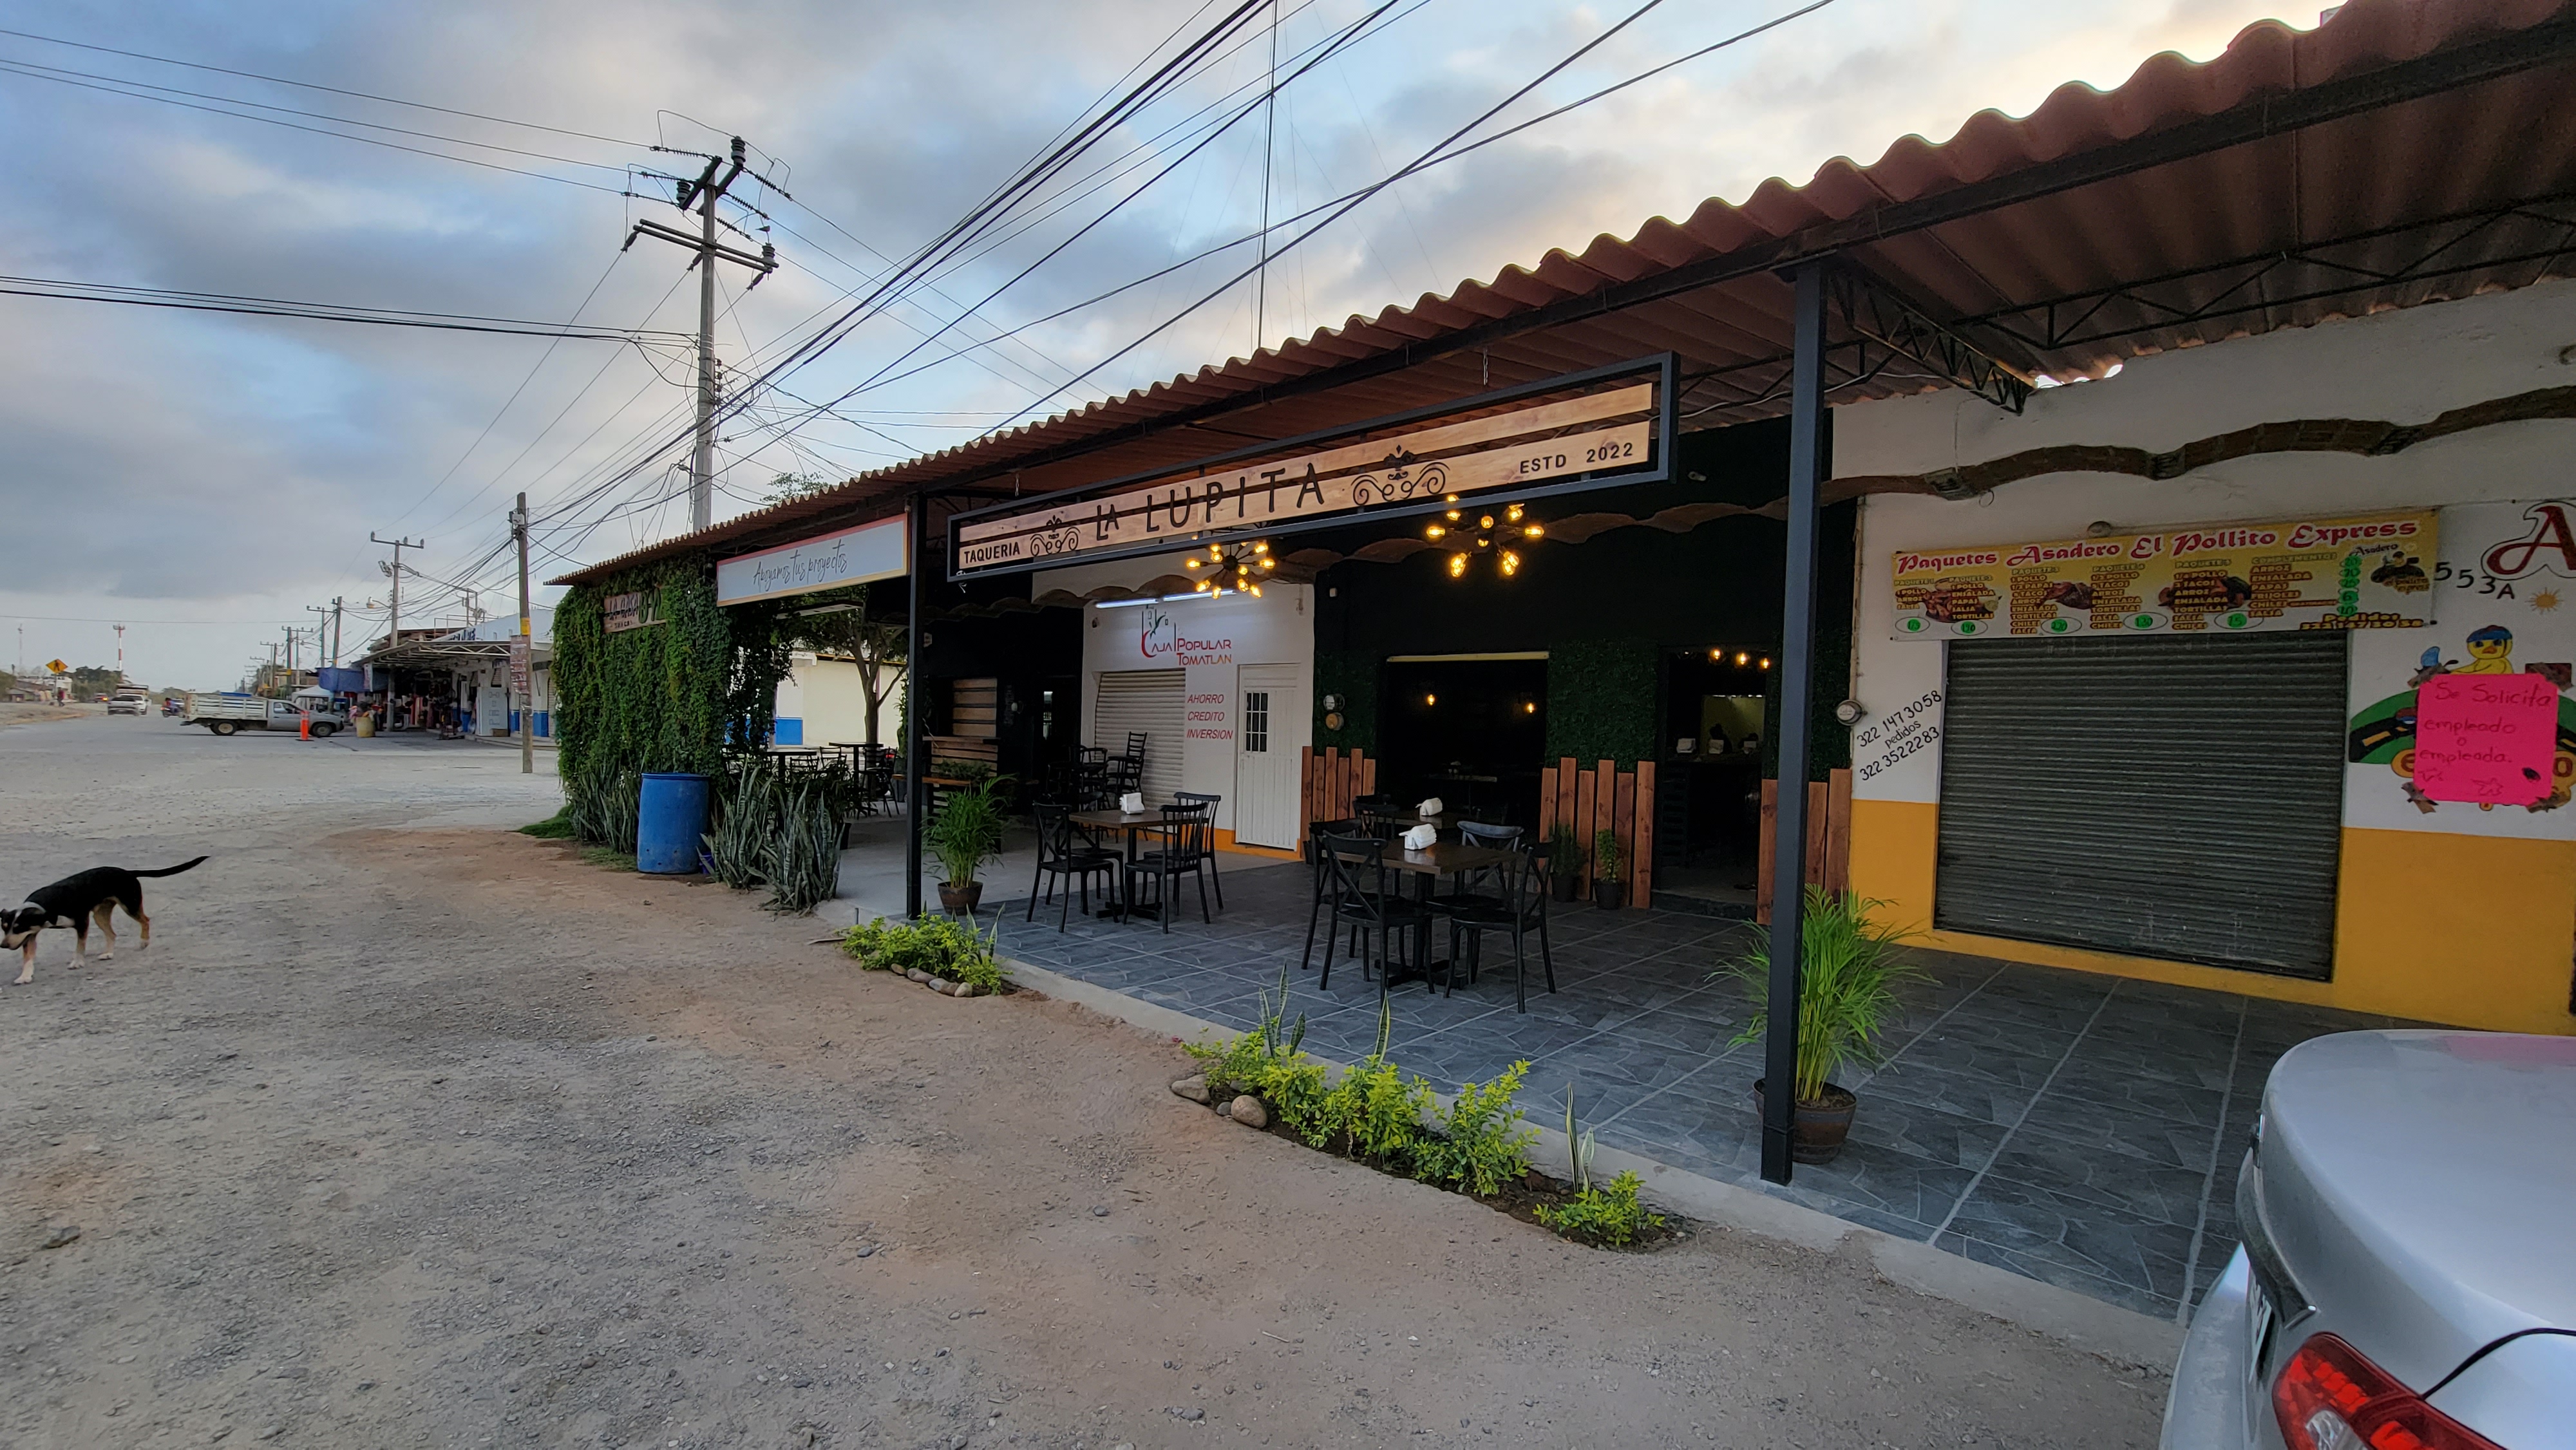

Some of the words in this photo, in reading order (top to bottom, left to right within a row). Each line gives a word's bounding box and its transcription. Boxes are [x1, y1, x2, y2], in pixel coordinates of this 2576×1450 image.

[1519, 454, 1566, 474] ESTD
[1586, 442, 1633, 464] 2022
[1096, 503, 1120, 541] LA
[1146, 462, 1325, 533] LUPITA
[963, 541, 1021, 565] TAQUERIA
[1898, 553, 1998, 574] Paquetes
[2006, 543, 2120, 567] Asadero
[2130, 536, 2162, 559] El
[2173, 530, 2276, 556] Pollito
[2287, 522, 2418, 548] Express
[2349, 543, 2398, 556] Asadero
[806, 539, 848, 585] proyectos
[2252, 565, 2290, 573] ARROZ
[2251, 573, 2311, 583] ENSALADA
[2251, 583, 2287, 591] PAPAS
[2433, 562, 2515, 599] 553A
[2251, 591, 2300, 599] FRIJOLES
[2324, 612, 2400, 623] Pedidos
[1141, 629, 1173, 658] CAJA
[1176, 638, 1232, 652] POPULAR
[1176, 652, 1232, 666] TOMATLAN
[1187, 693, 1224, 704] AHORRO
[2434, 681, 2461, 701] Se
[2472, 683, 2552, 707] Solicita
[1188, 711, 1225, 721] CREDITO
[2423, 716, 2517, 736] empleado
[1186, 729, 1233, 740] INVERSION
[1857, 726, 1881, 747] 322
[1884, 720, 1921, 749] pedidos
[1859, 760, 1883, 780] 322
[1882, 726, 1940, 767] 3522283
